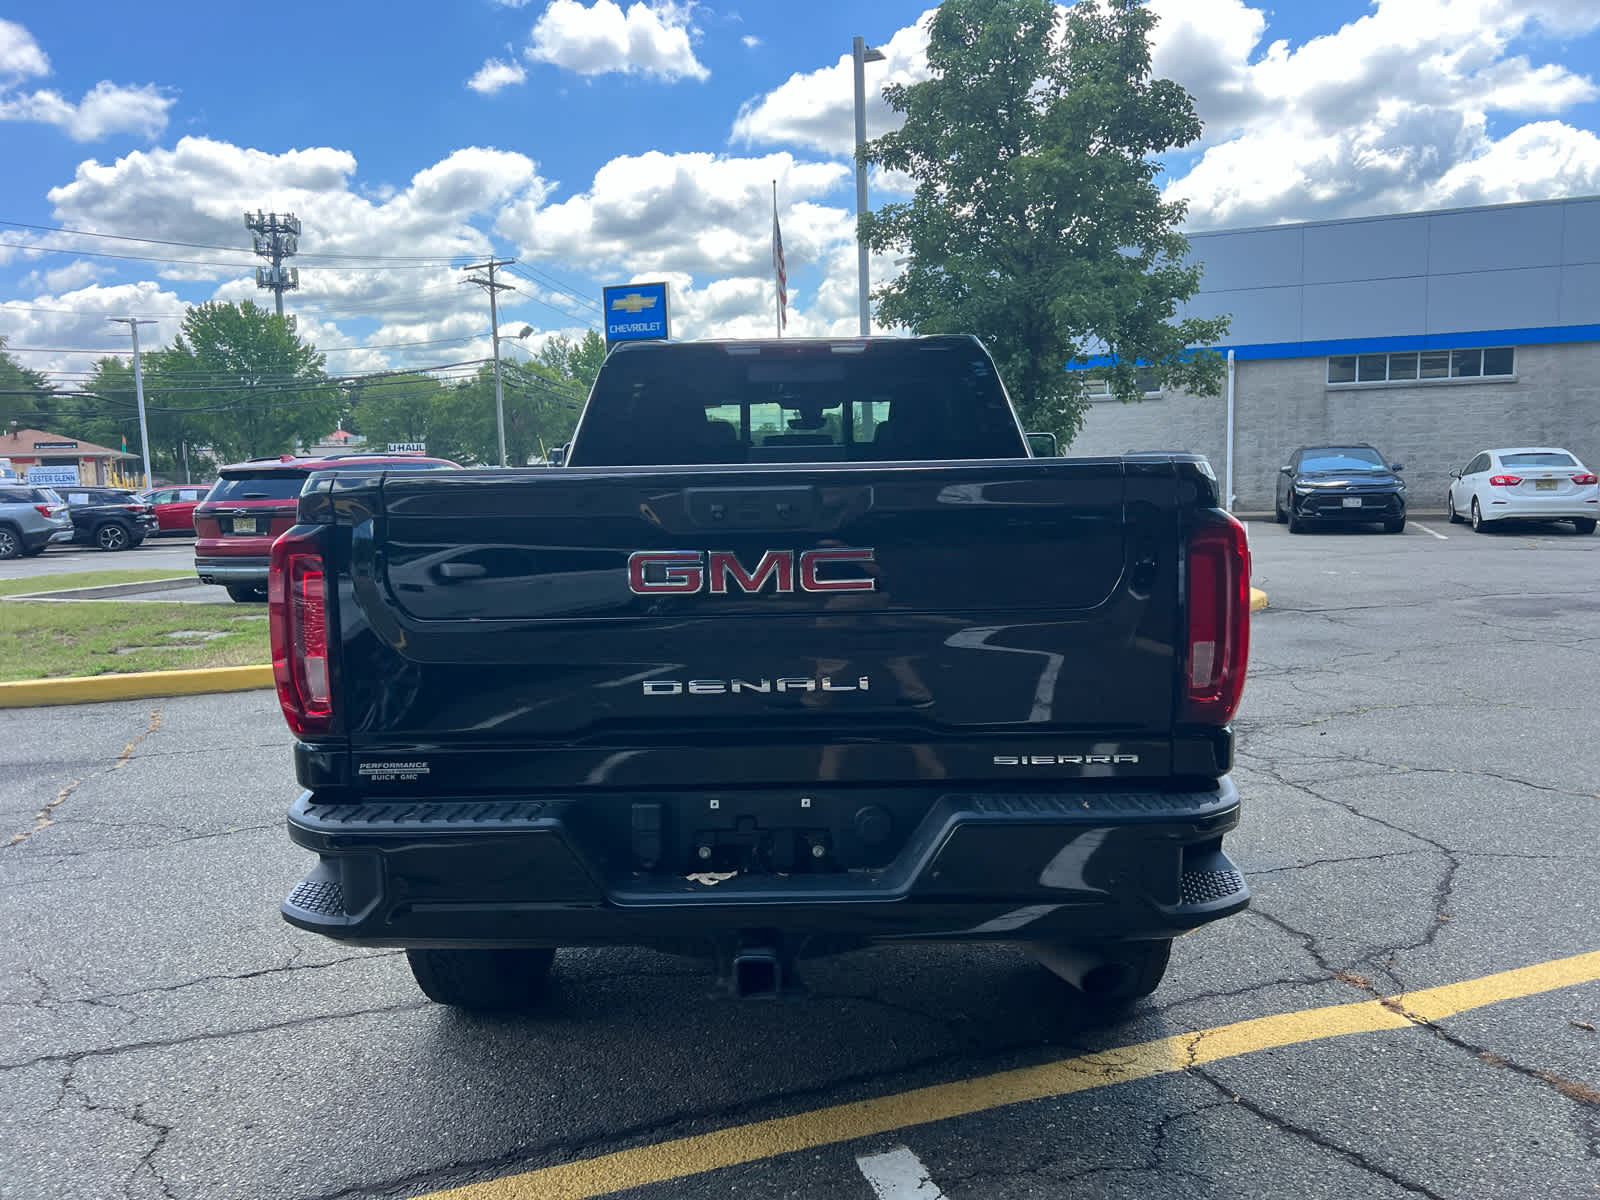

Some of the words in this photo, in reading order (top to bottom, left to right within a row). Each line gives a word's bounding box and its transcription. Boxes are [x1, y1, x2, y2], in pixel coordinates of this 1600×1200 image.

[609, 322, 660, 334] CHEVROLET
[29, 475, 53, 483] LESTER
[54, 474, 76, 482] GLENN
[627, 548, 875, 595] GMC
[993, 754, 1139, 765] SIERRA
